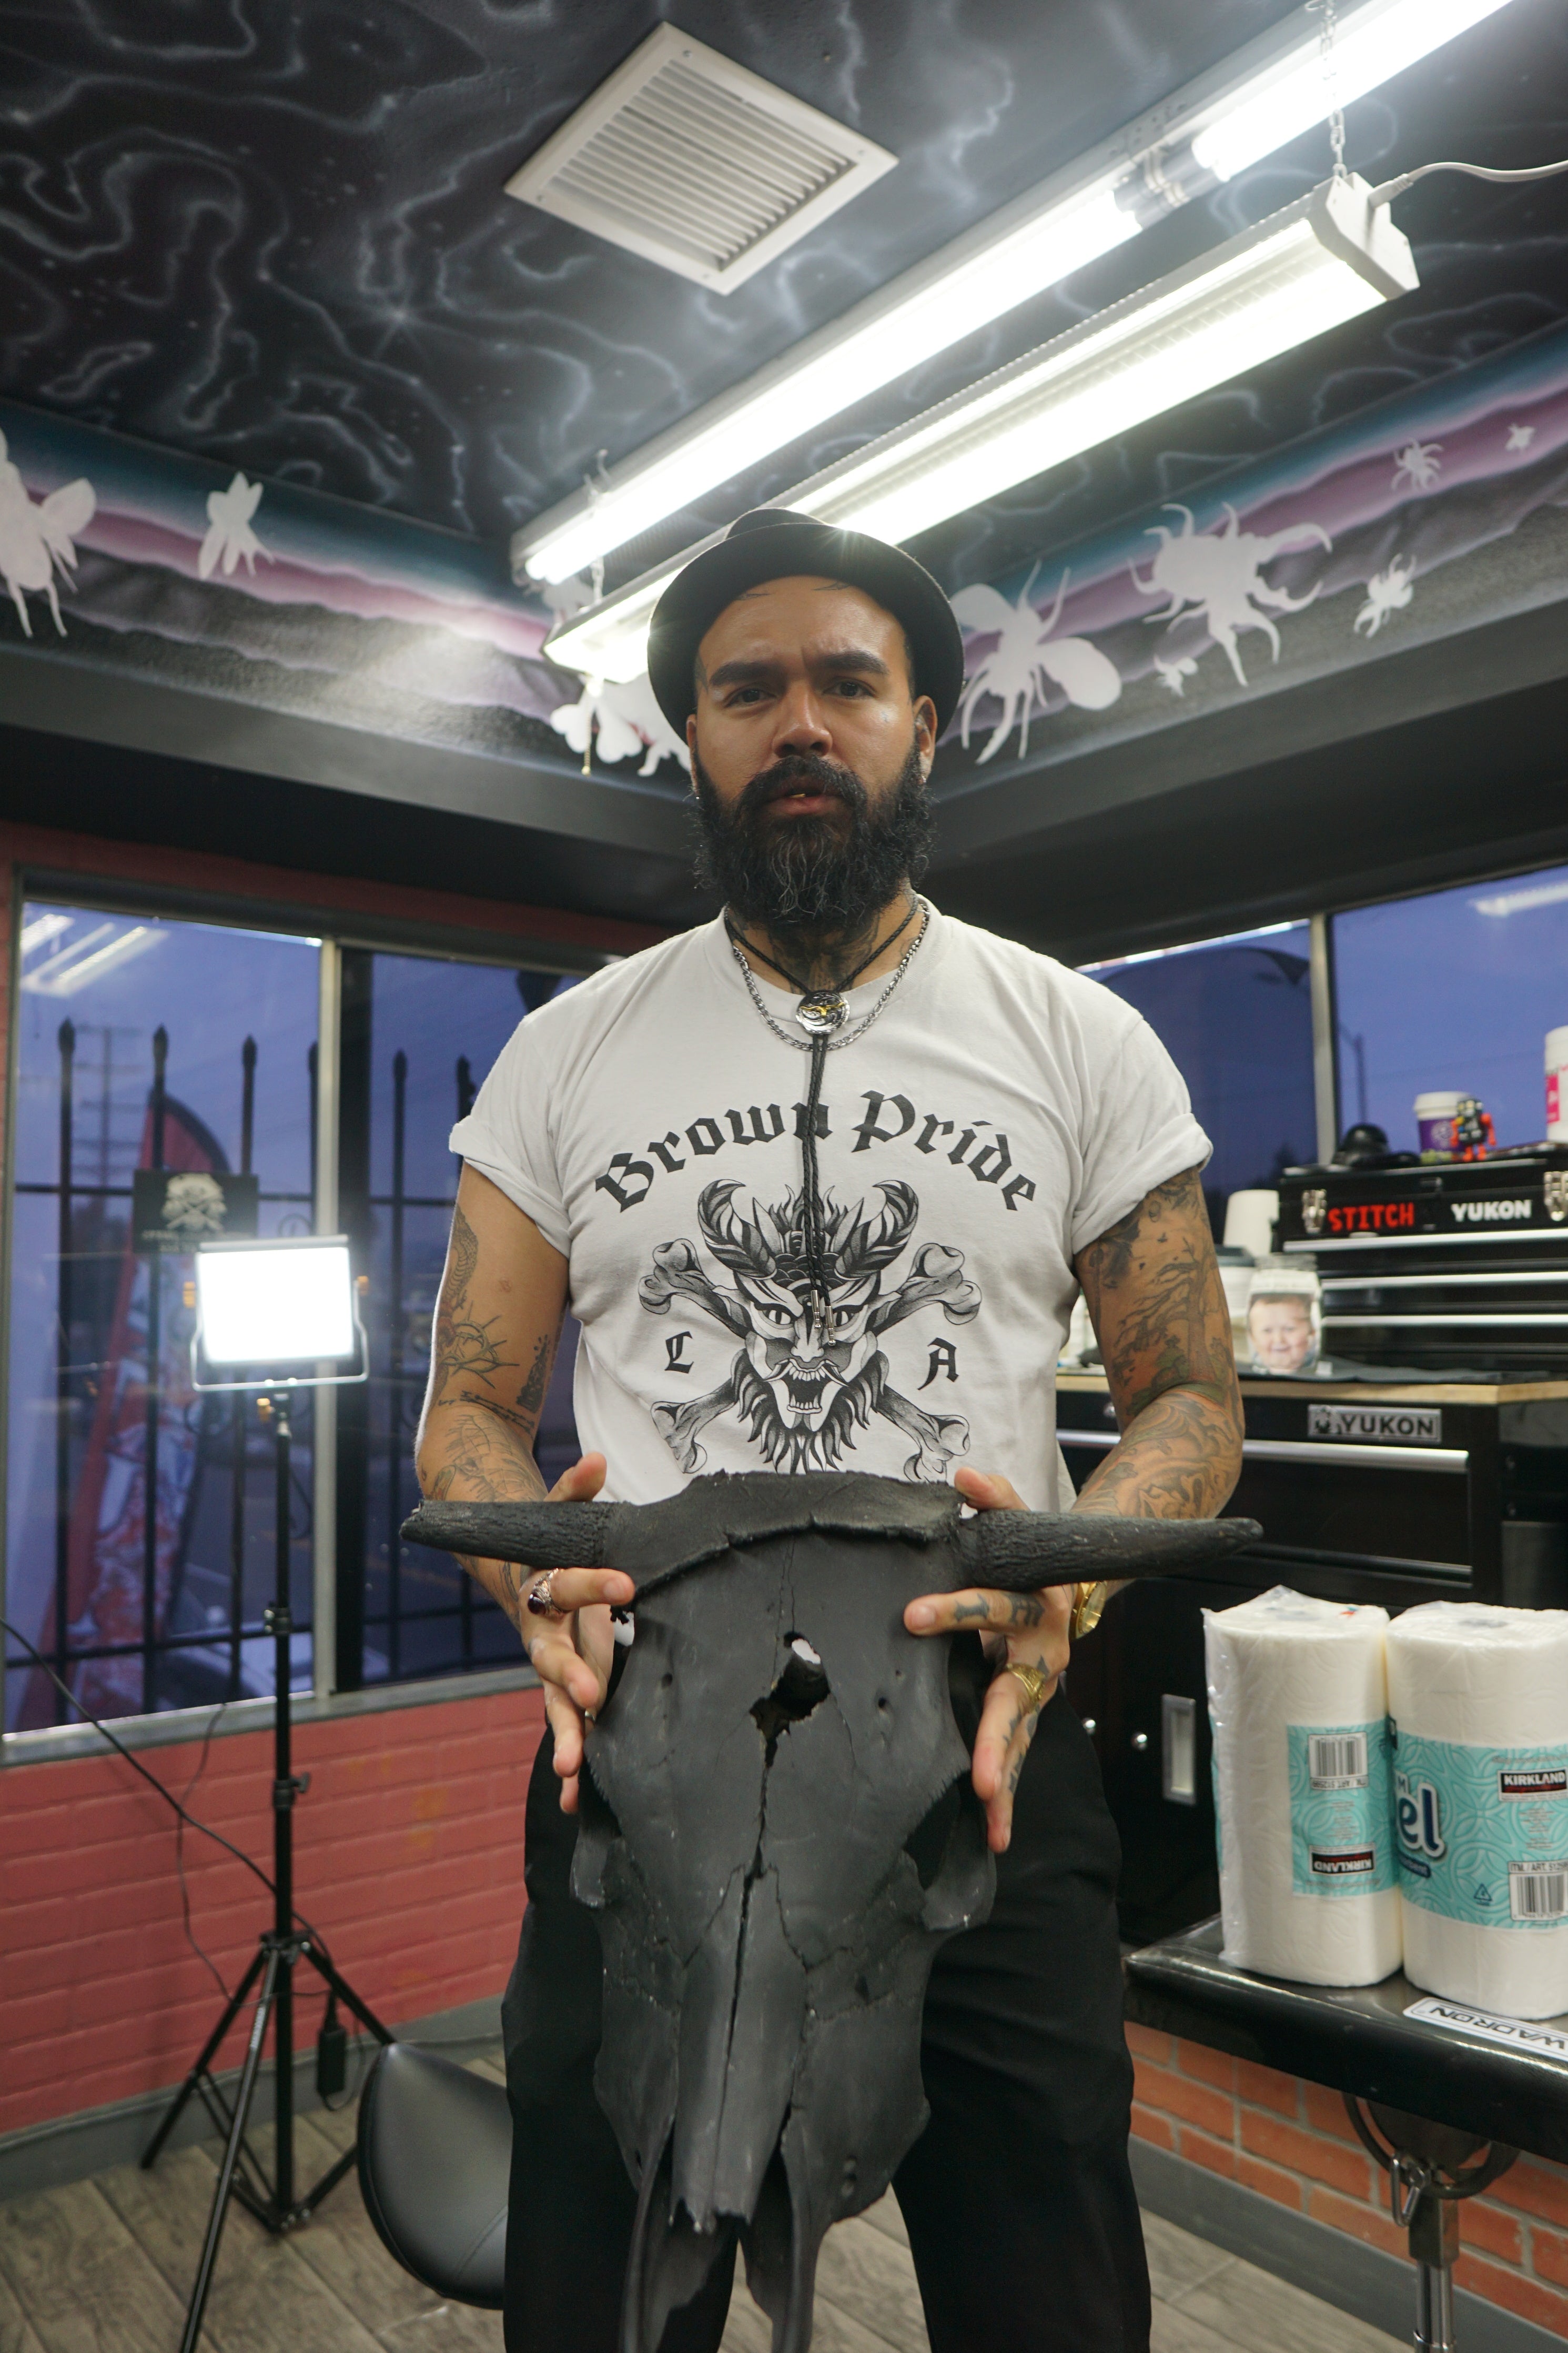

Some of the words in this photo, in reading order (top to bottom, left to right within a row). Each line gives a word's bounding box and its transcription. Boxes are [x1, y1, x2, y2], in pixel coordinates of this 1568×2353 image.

[595, 1103, 833, 1213] Brown
[851, 1090, 1036, 1211] Pride
[1327, 1202, 1415, 1232] STITCH
[1451, 1199, 1532, 1222] YUKON
[917, 1337, 959, 1391] A
[1342, 1413, 1433, 1435] YUKON
[1503, 1771, 1566, 1786] KIRKLAND
[1314, 1859, 1372, 1873] KIRKLAND
[1430, 2007, 1565, 2050] WADRON
